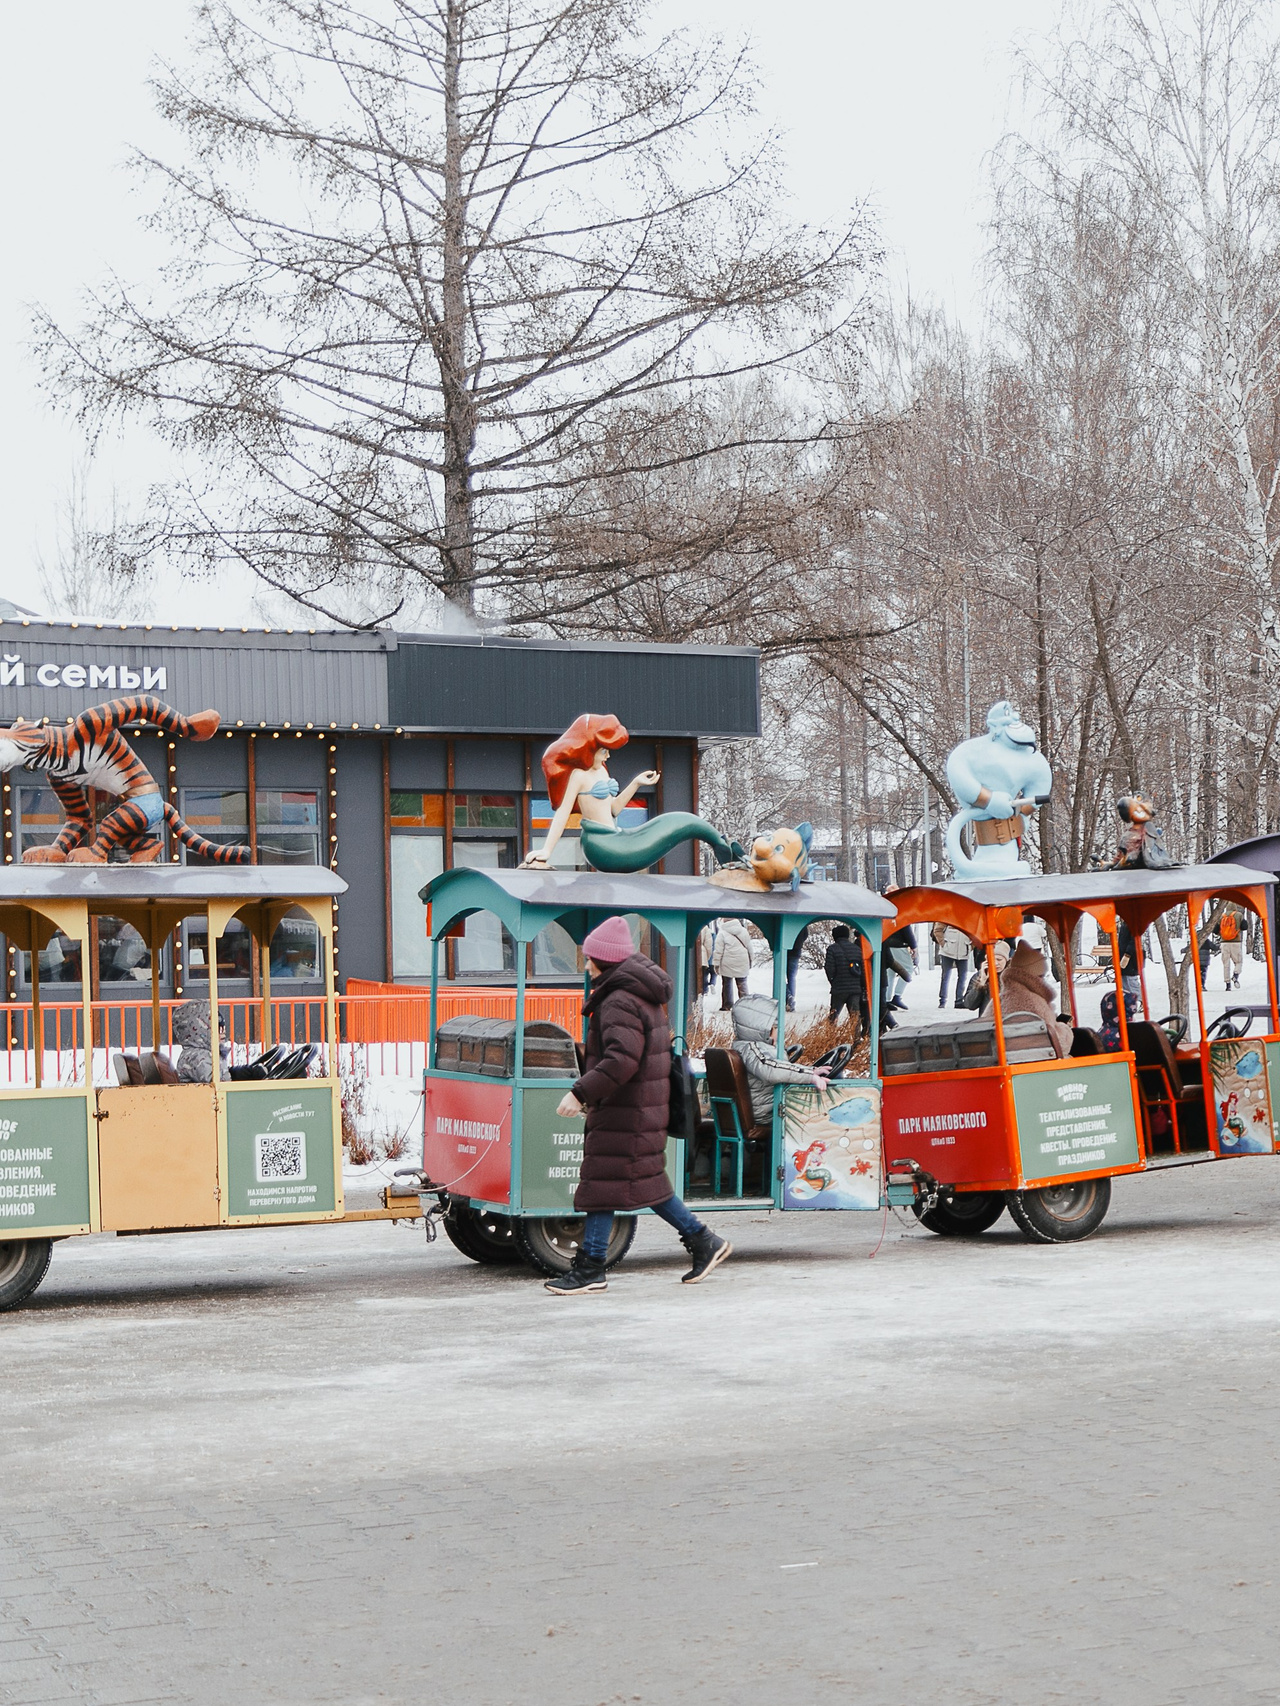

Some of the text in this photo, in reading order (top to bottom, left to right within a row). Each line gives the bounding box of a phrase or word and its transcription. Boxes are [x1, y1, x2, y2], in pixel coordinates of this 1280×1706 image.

[36, 663, 168, 690] семьи
[1057, 1083, 1088, 1097] ДИВНОЕ
[1063, 1093, 1084, 1102] МЕСТО
[1039, 1104, 1112, 1123] ТЕАТРАЛИЗОВАННЫЕ
[437, 1117, 500, 1142] ПАРК МАЯКОВСКОГО
[899, 1112, 987, 1134] ПАРК МАЯКОВСКОГО
[1072, 1133, 1117, 1149] ПРОВЕДЕНИЕ
[1058, 1150, 1105, 1166] ПРАЗДНИКОВ
[247, 1185, 318, 1197] НАХОДИМСЯ НАПРОТИВ
[249, 1195, 316, 1207] ПЕРЕВЕРНУТОГО ДОМА
